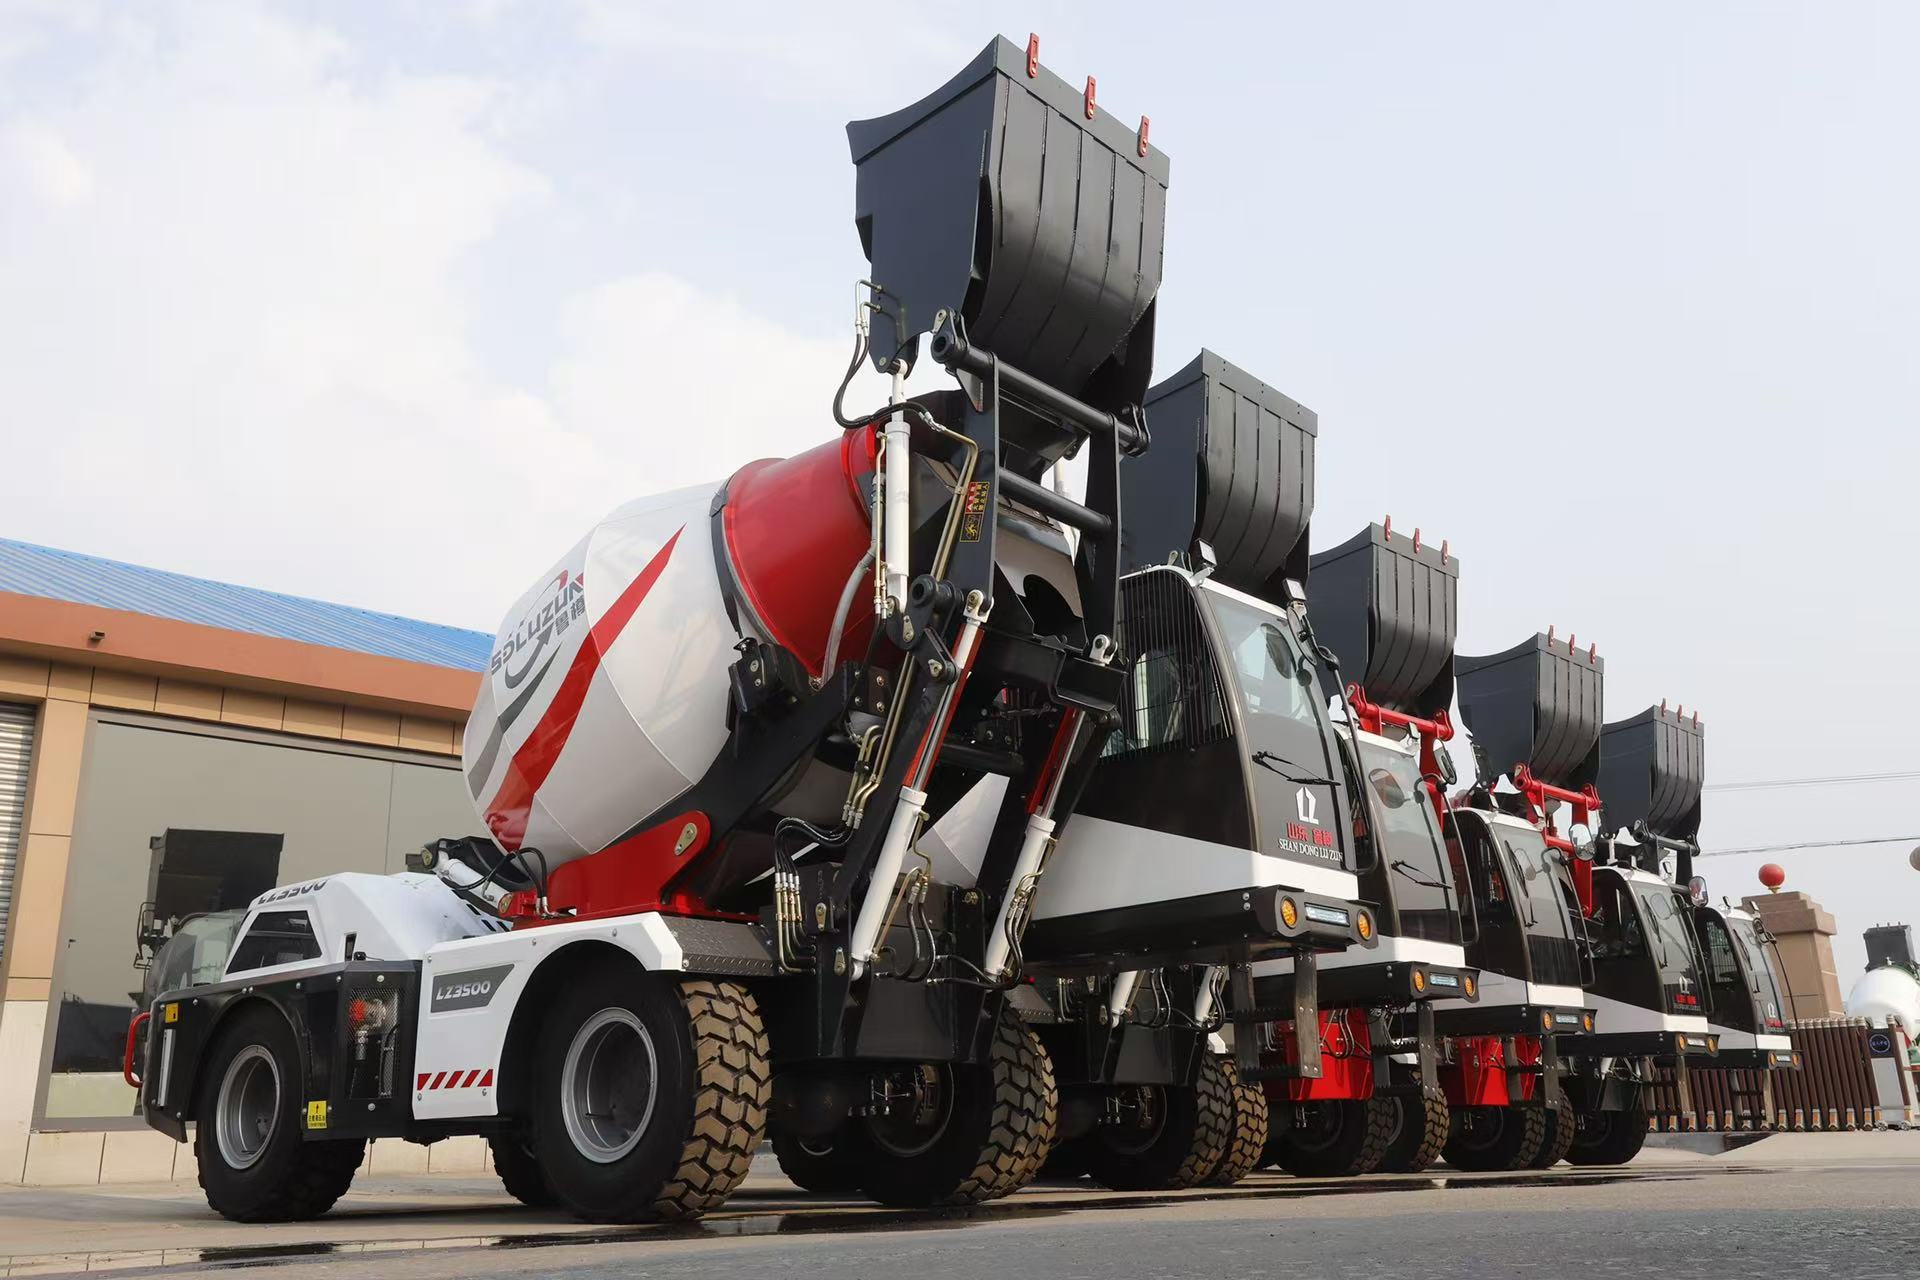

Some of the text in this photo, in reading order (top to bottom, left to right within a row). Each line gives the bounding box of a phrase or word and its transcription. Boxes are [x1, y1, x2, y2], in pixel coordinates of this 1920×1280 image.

[1279, 838, 1299, 853] SHAN
[1299, 842, 1319, 858] DONG
[435, 980, 491, 1001] LZ3500
